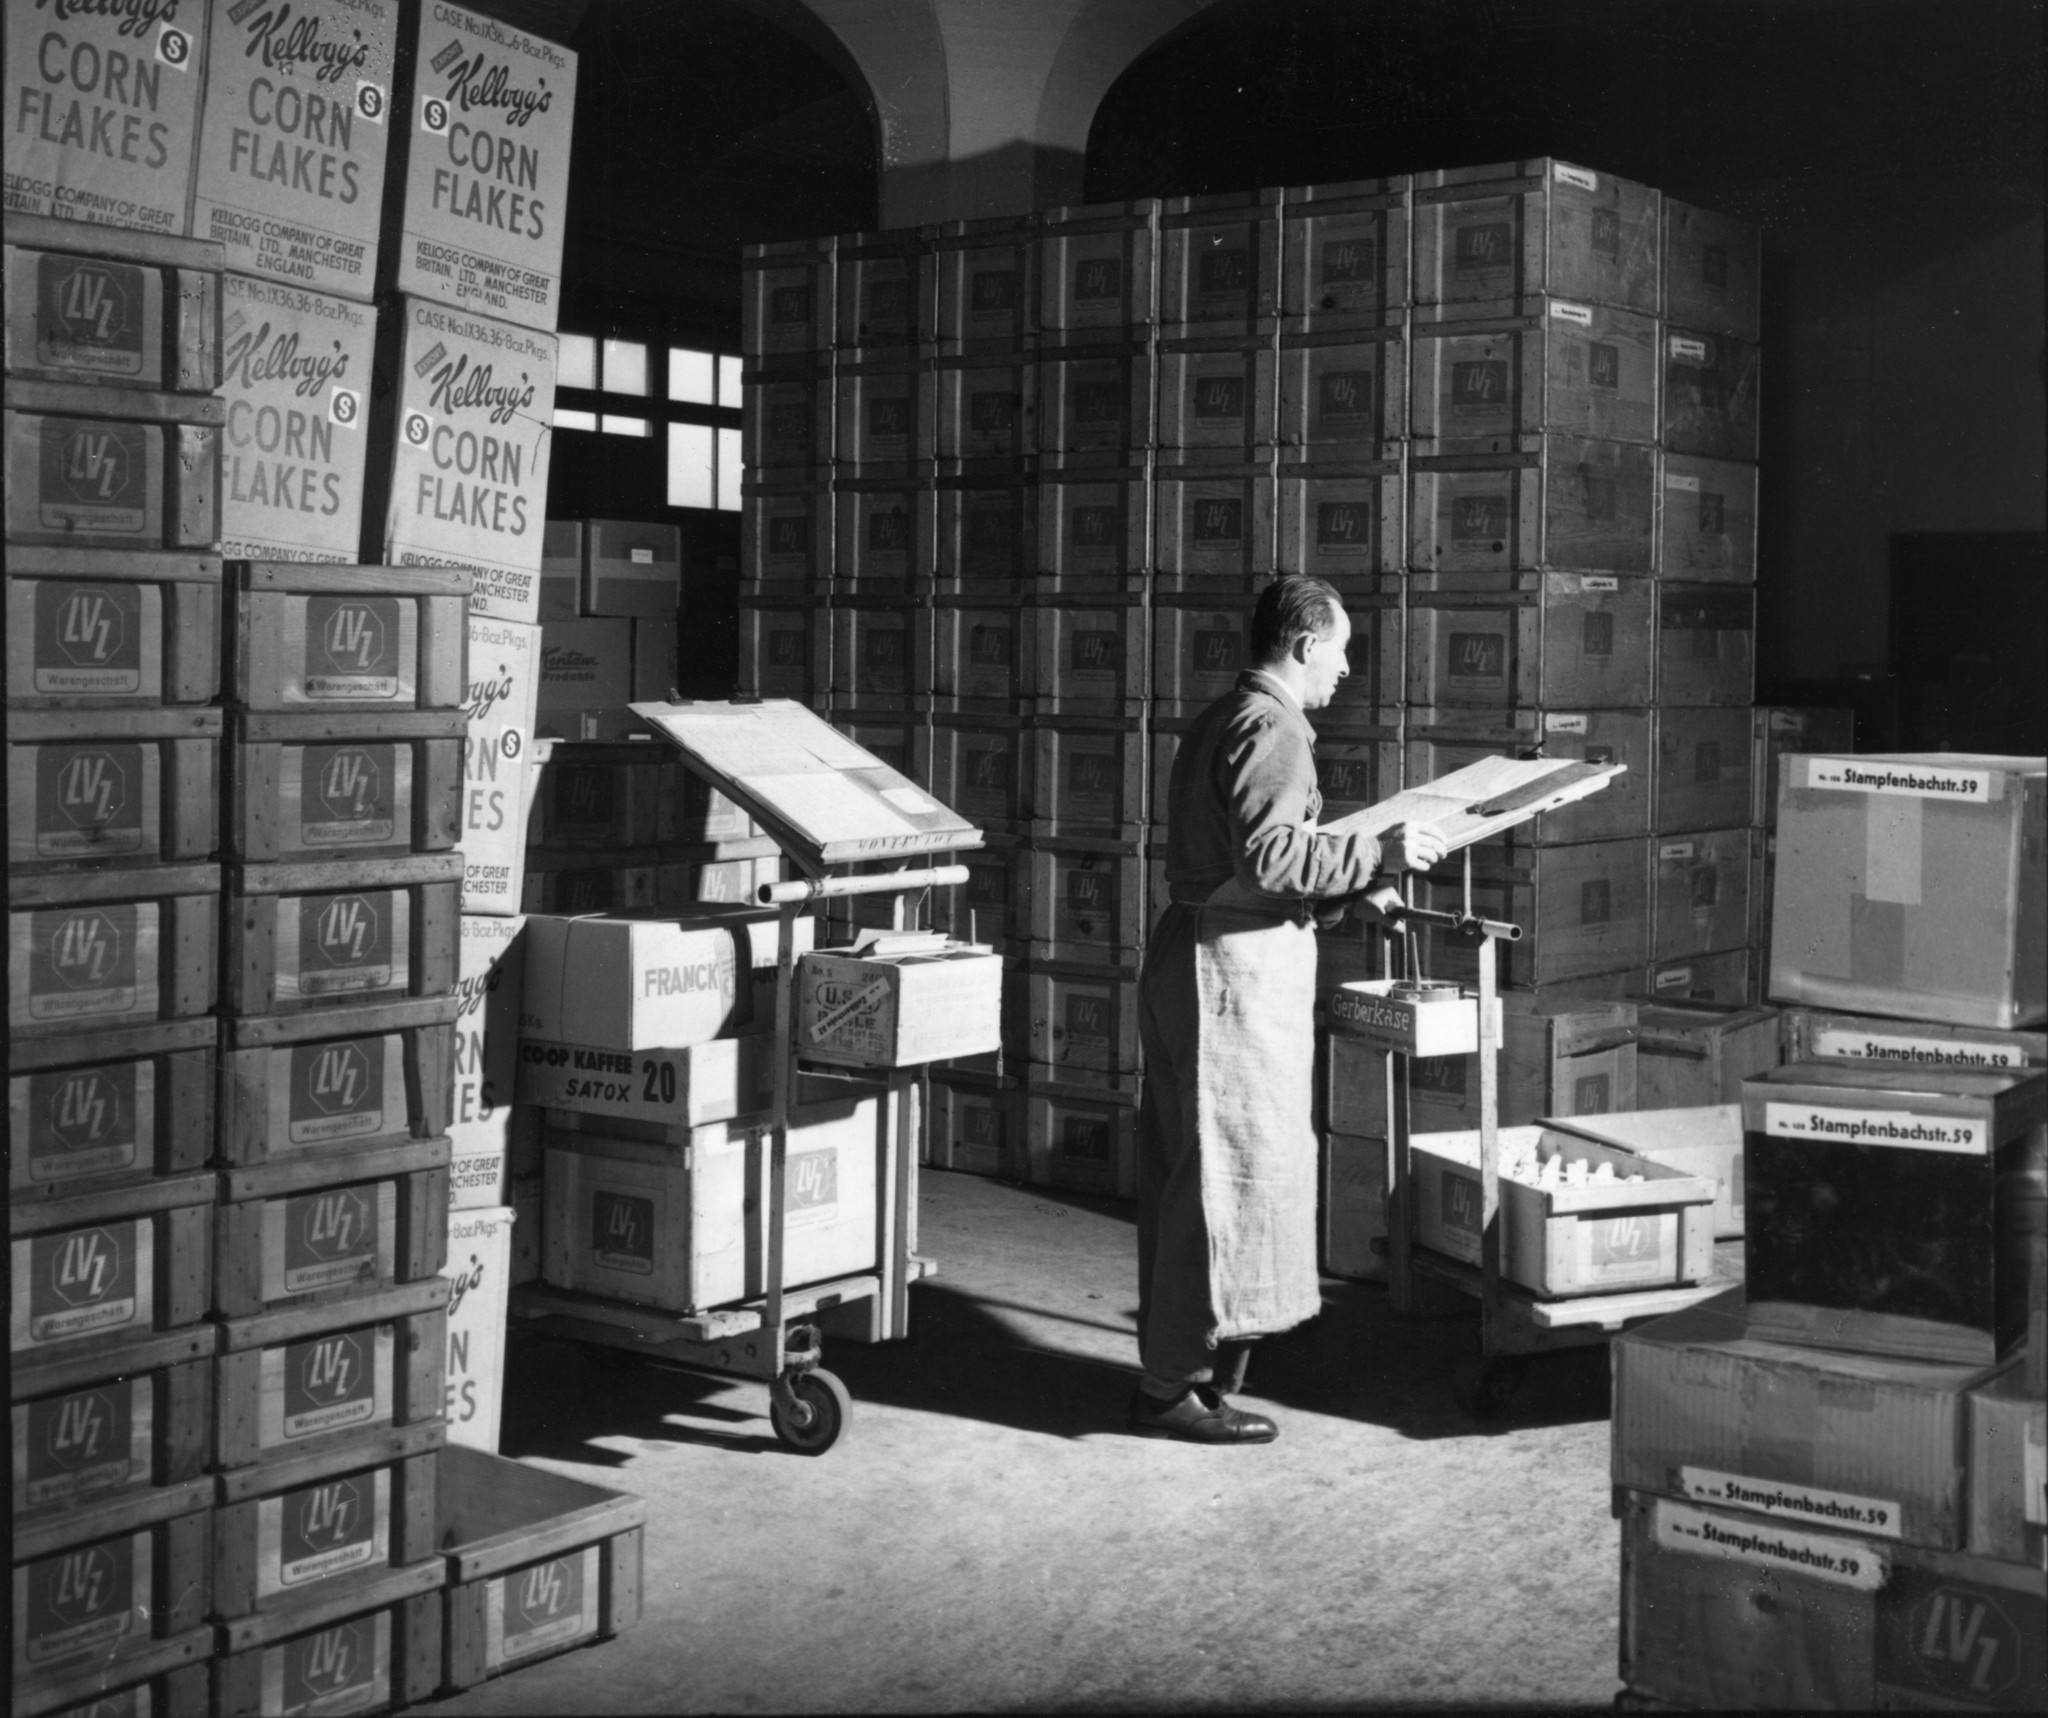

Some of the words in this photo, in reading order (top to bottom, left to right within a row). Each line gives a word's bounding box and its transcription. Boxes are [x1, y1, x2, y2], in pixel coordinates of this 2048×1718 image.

[434, 4, 462, 29] CASE
[245, 2, 369, 83] Kellogg's
[38, 31, 160, 112] CORN
[446, 53, 552, 127] Kellogg's
[17, 86, 168, 169] FLAKES
[248, 77, 353, 152] CORN
[229, 127, 359, 204] FLAKES
[448, 122, 538, 191] CORN
[55, 186, 119, 212] COMPANY
[119, 201, 136, 216] OF
[139, 204, 175, 228] GREAT
[432, 168, 544, 240] FLAKES
[211, 207, 260, 233] KELLOGG
[262, 221, 317, 248] COMPANY
[316, 233, 332, 250] OF
[333, 238, 366, 260] GREAT
[256, 253, 316, 281] ENGLAND.
[288, 243, 362, 275] MANCHESTER
[417, 241, 459, 265] KELLOGG
[461, 253, 507, 279] COMPANY
[506, 266, 521, 282] OF
[522, 269, 550, 291] GREAT
[483, 275, 548, 305] MANCHESTER
[416, 307, 445, 331] CASE
[224, 322, 349, 397] Kellogg's
[429, 354, 535, 424] Kellogg's
[227, 400, 333, 463] CORN
[431, 425, 521, 487] CORN
[416, 473, 527, 536] FLAKES
[244, 543, 297, 561] COMPANY
[490, 569, 503, 582] OF
[504, 573, 532, 588] GREAT
[316, 679, 388, 693] Warengeschäft
[466, 865, 480, 879] OF
[482, 864, 511, 880] GREAT
[645, 962, 719, 998] FRANCK
[1333, 993, 1410, 1032] Gerberkäse
[565, 1078, 631, 1102] SATOX
[642, 1060, 676, 1104] 20
[574, 1050, 632, 1075] KAFFEE
[457, 1159, 472, 1174] OF
[472, 1156, 501, 1173] GREAT
